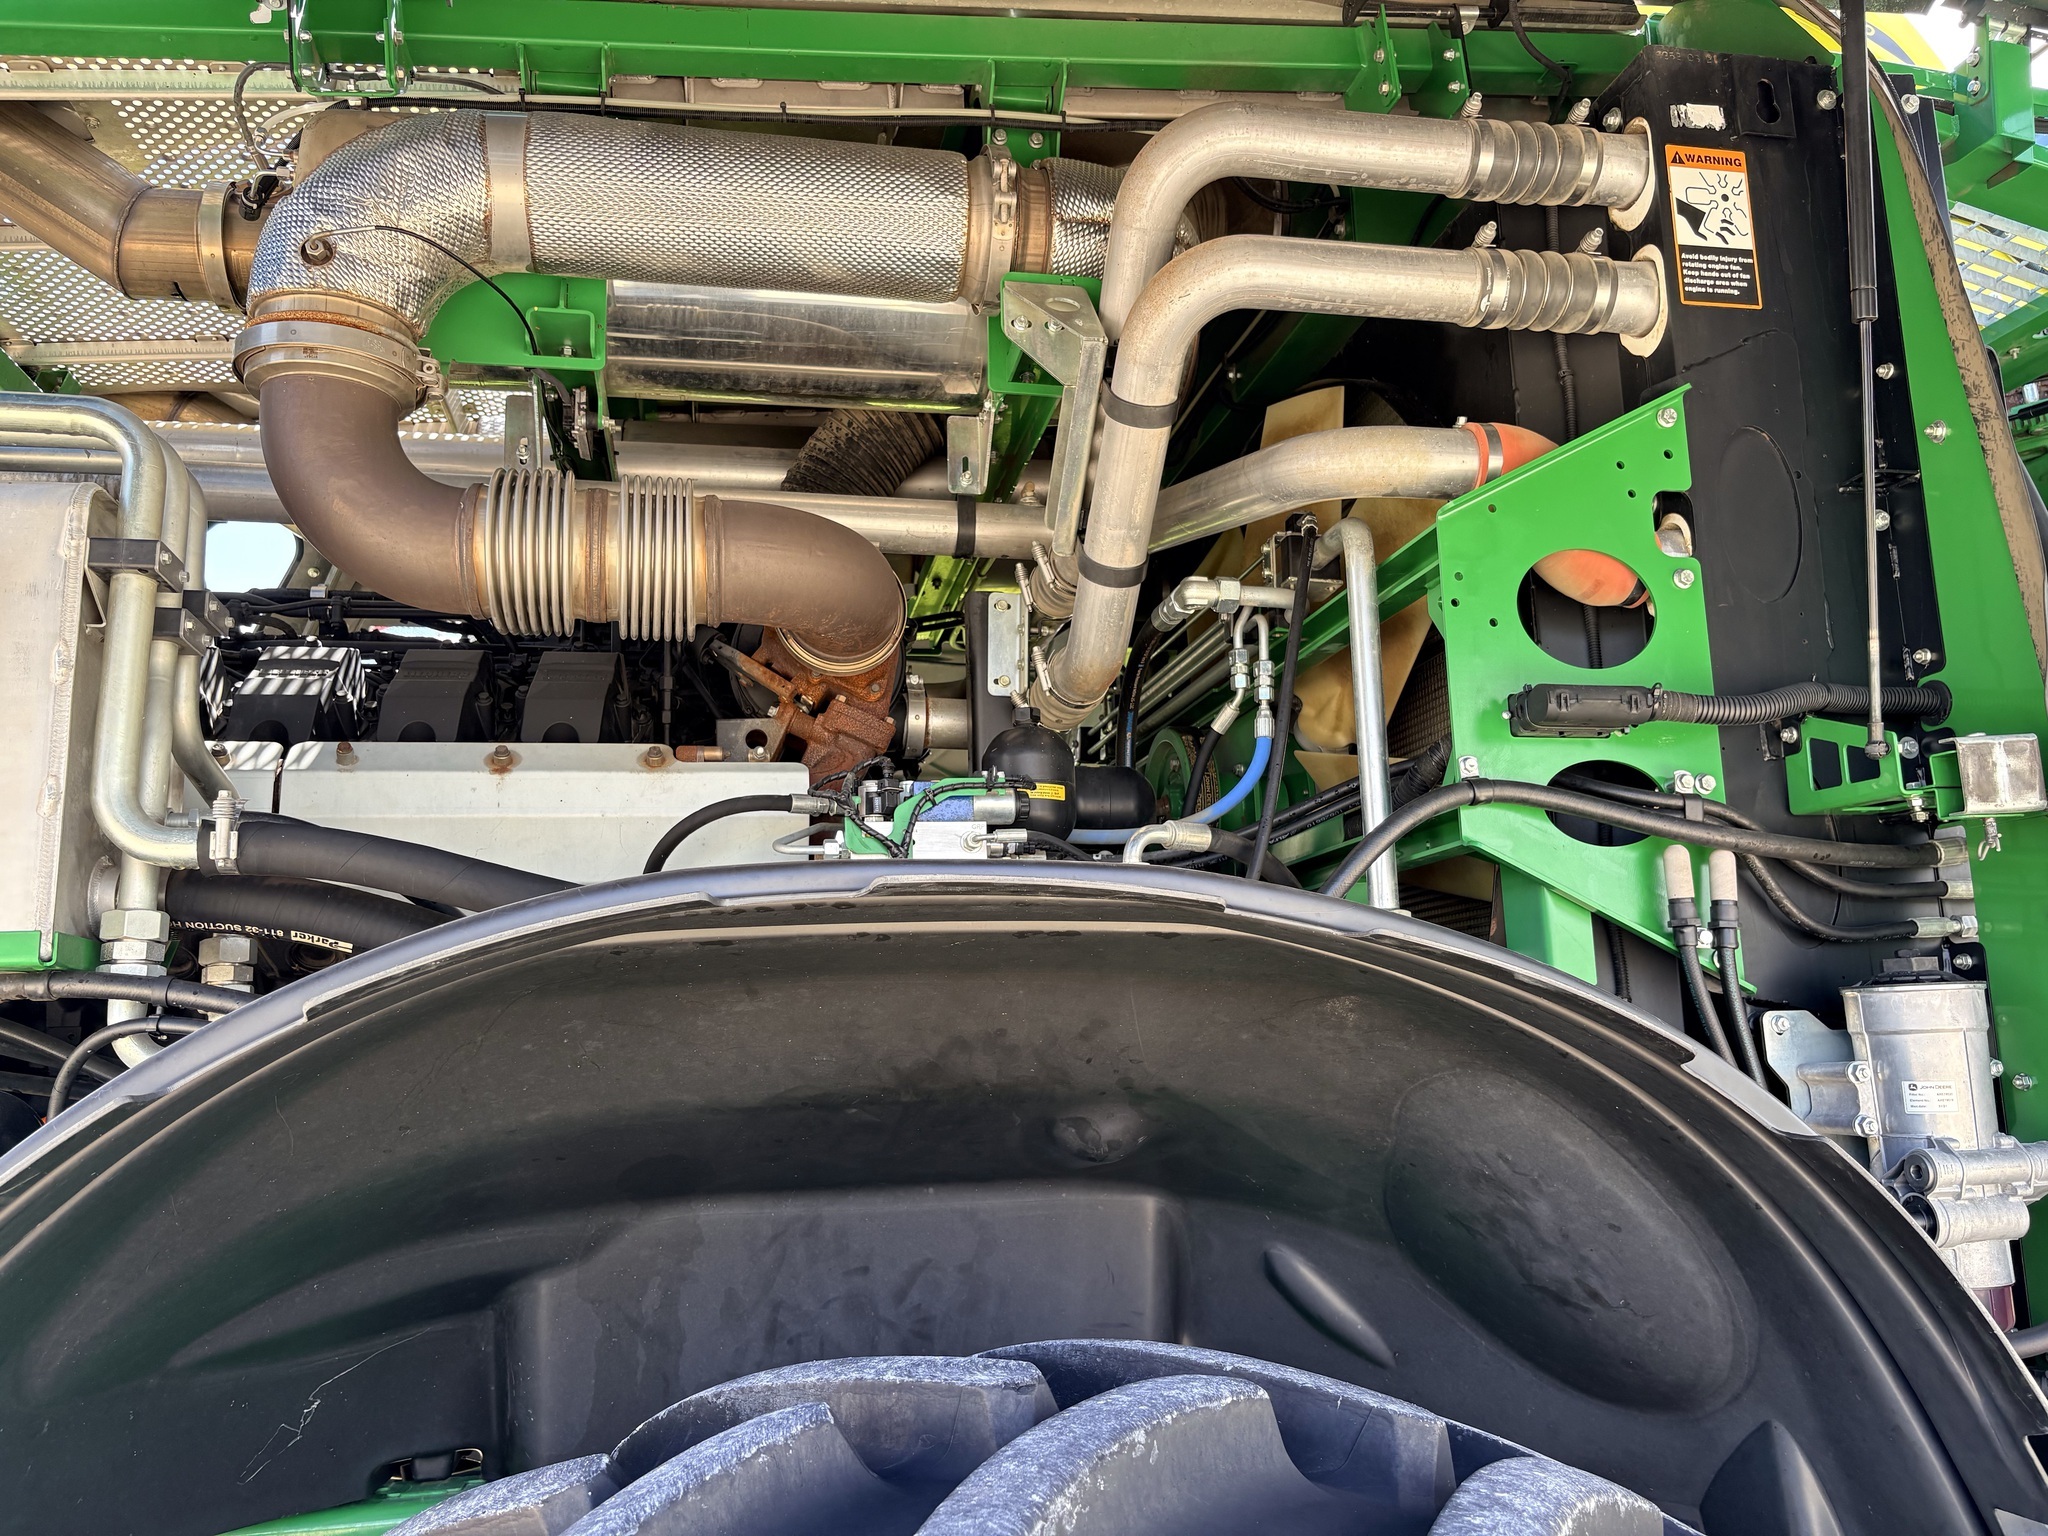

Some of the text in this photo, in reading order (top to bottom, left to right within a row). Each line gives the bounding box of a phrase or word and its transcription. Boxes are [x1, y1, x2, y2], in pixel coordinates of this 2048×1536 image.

[1684, 153, 1742, 167] WARNING
[1700, 254, 1719, 262] bodily
[1720, 255, 1738, 263] injury
[1682, 261, 1707, 269] rotating
[1683, 277, 1714, 286] discharge
[1714, 288, 1740, 296] running.
[185, 921, 242, 932] SUCTION
[245, 925, 285, 938] 811-32
[292, 931, 340, 949] Parker
